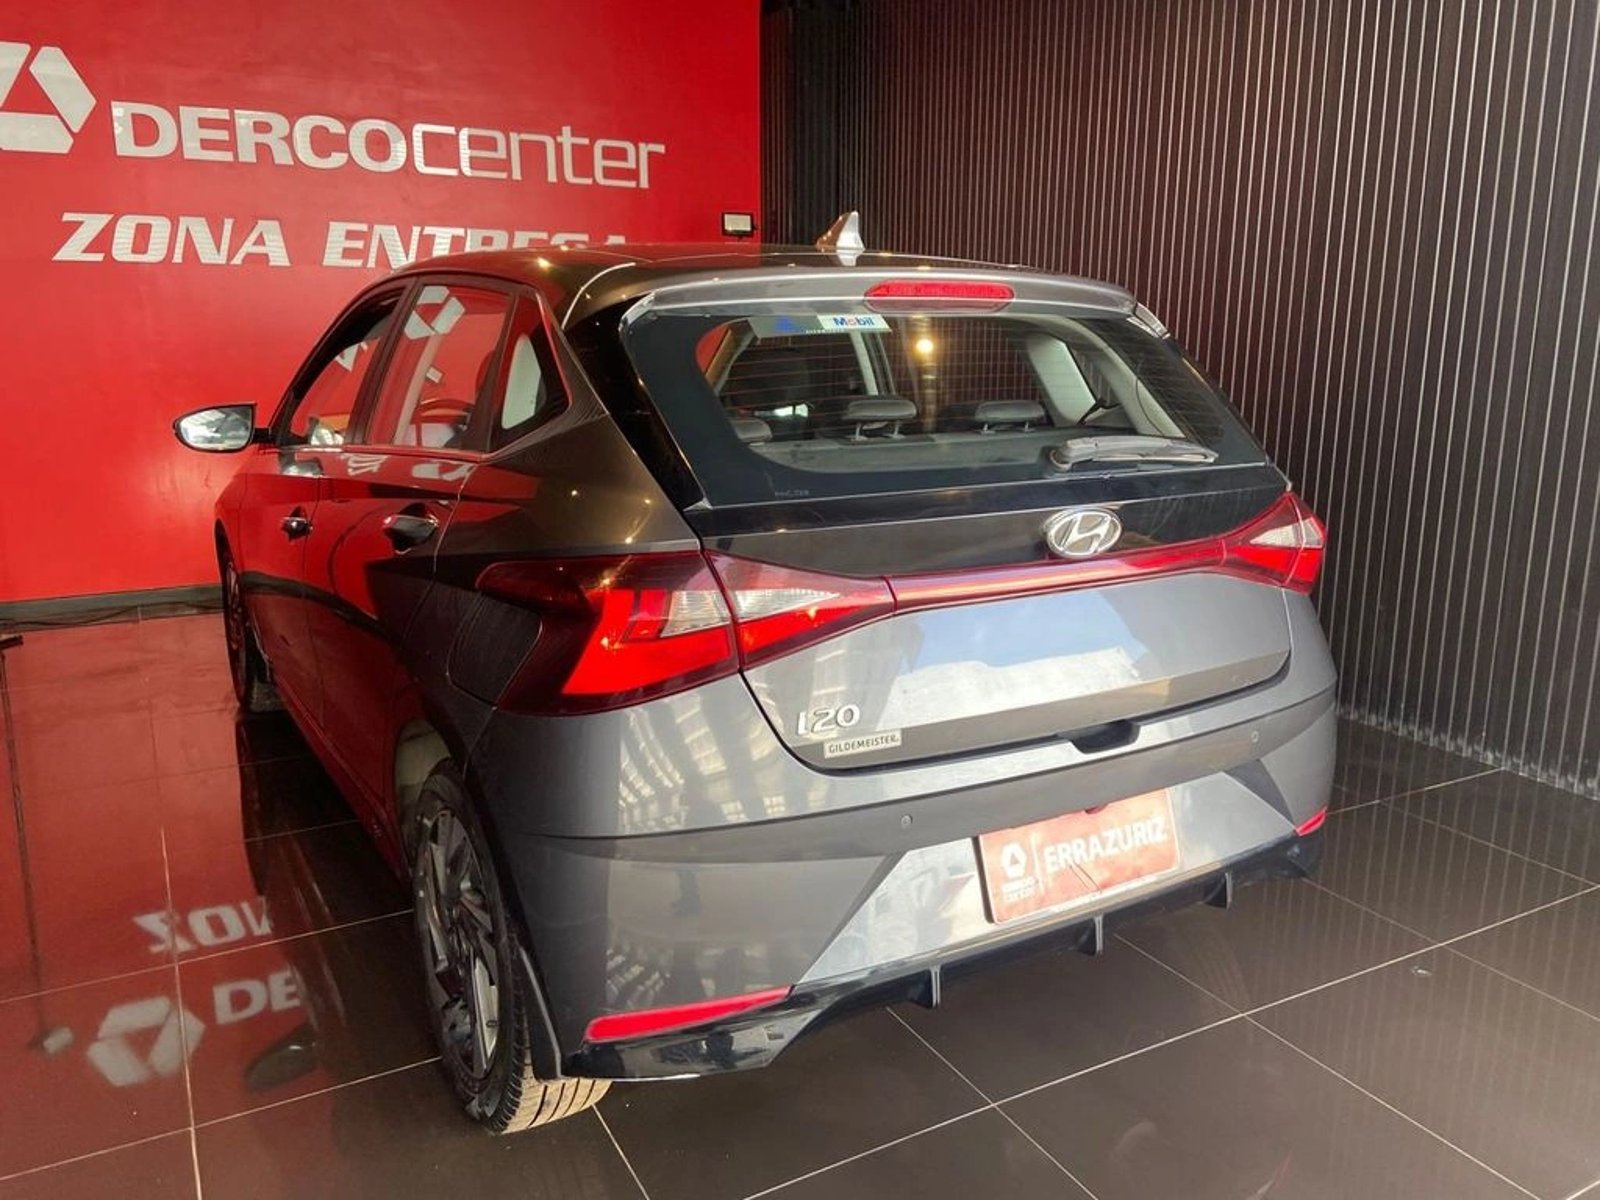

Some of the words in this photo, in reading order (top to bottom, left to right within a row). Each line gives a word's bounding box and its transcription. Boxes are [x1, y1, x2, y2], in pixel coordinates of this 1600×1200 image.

[51, 212, 292, 267] ZONA
[832, 316, 875, 327] Mobil
[1044, 815, 1168, 875] ERRAZURIZ
